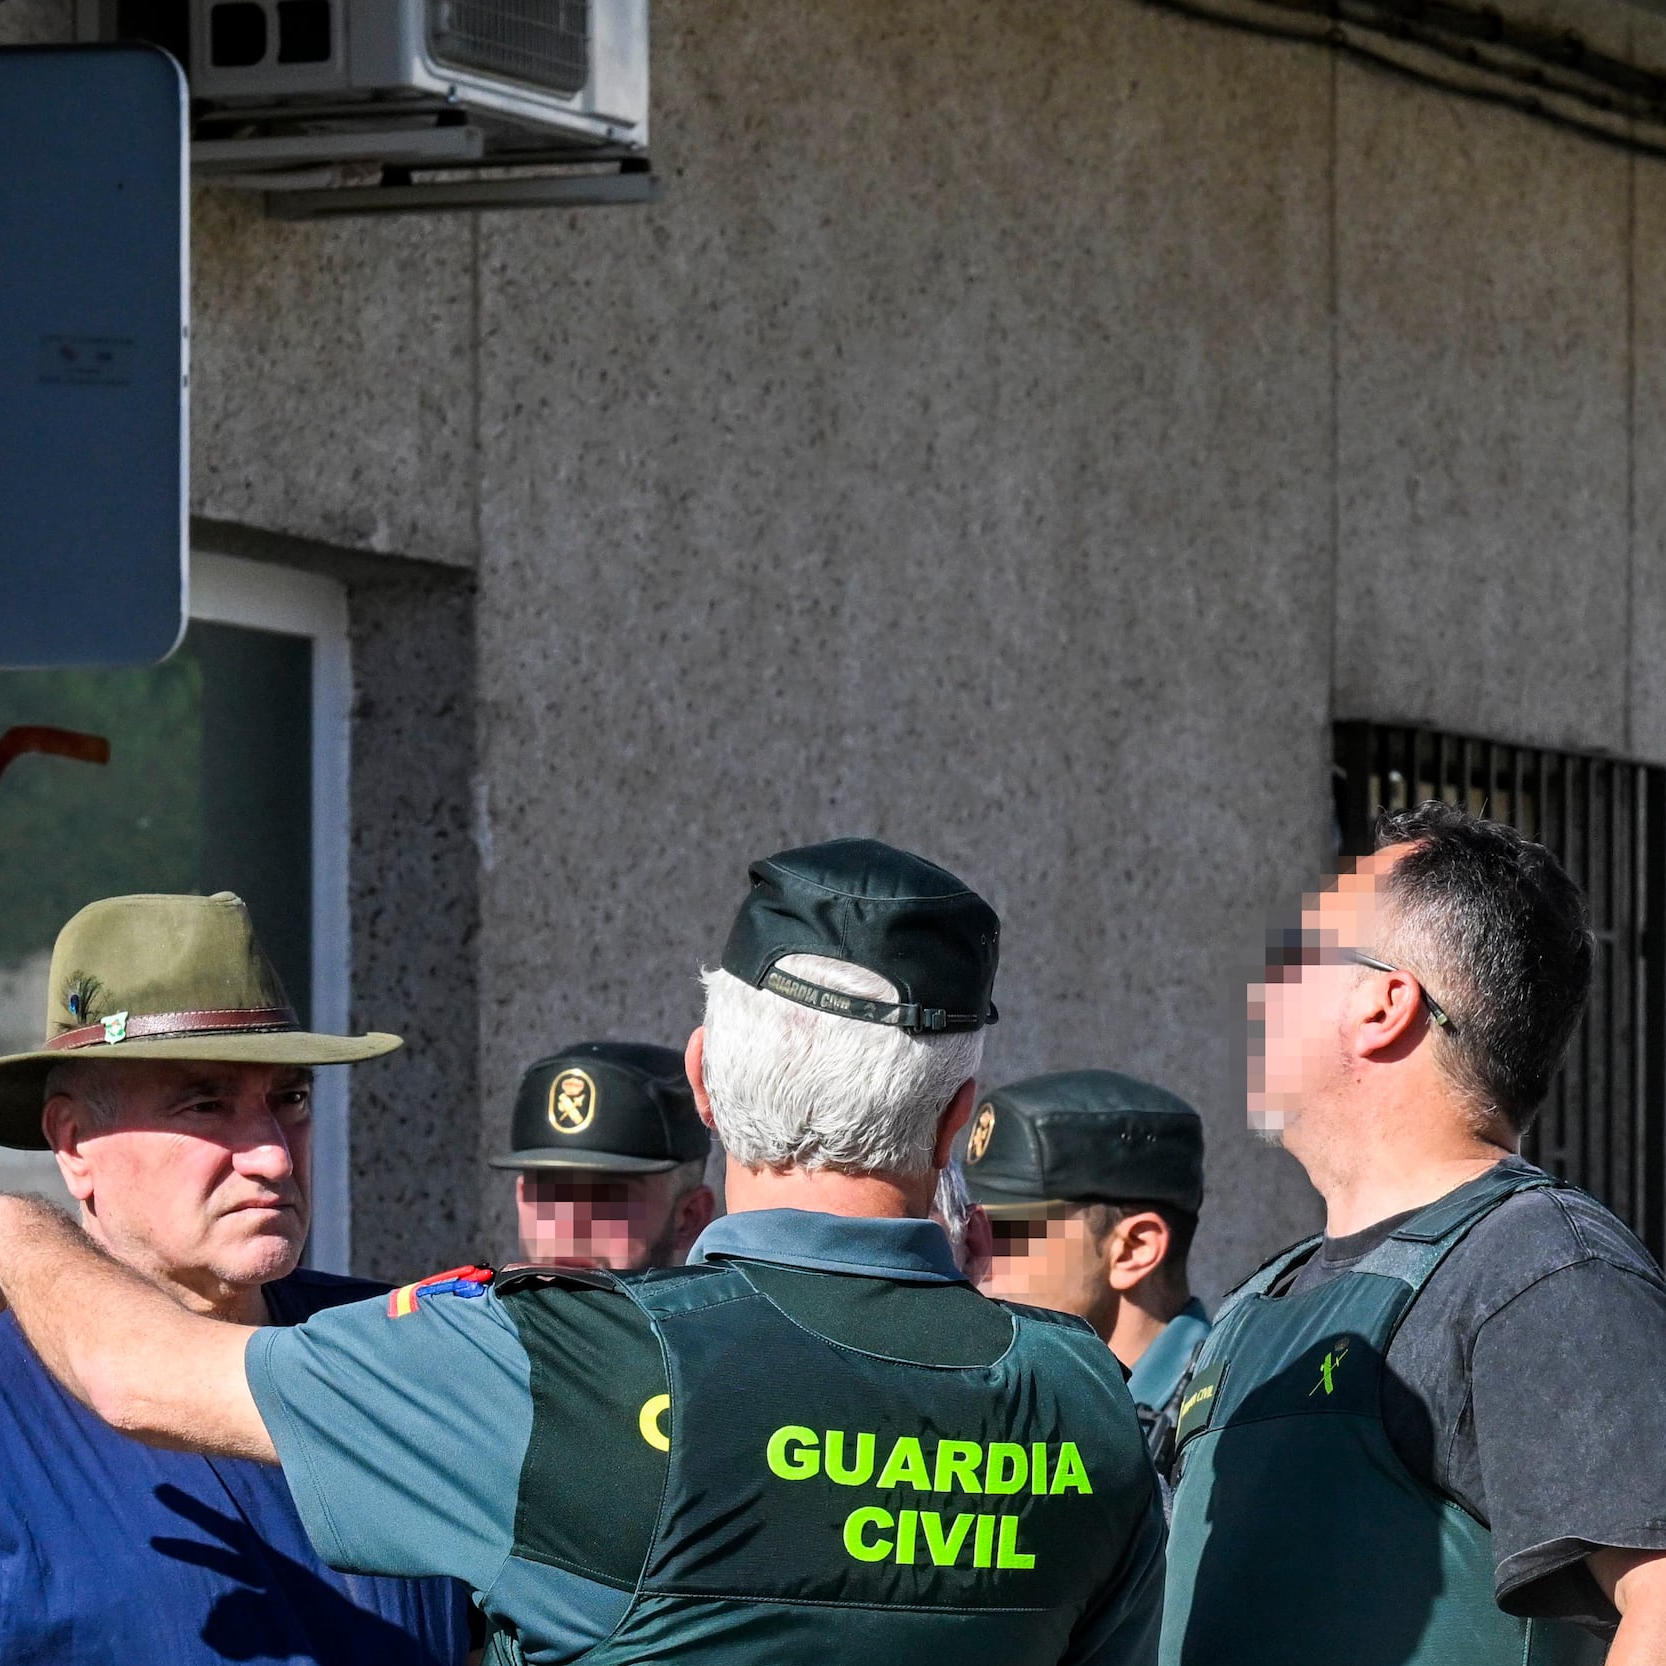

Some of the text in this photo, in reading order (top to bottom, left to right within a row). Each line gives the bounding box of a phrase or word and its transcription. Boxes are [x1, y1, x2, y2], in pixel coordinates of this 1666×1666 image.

[768, 972, 818, 1006] GUARDIA
[767, 1426, 1093, 1495] GUARDIA
[843, 1506, 1036, 1570] CIVIL
